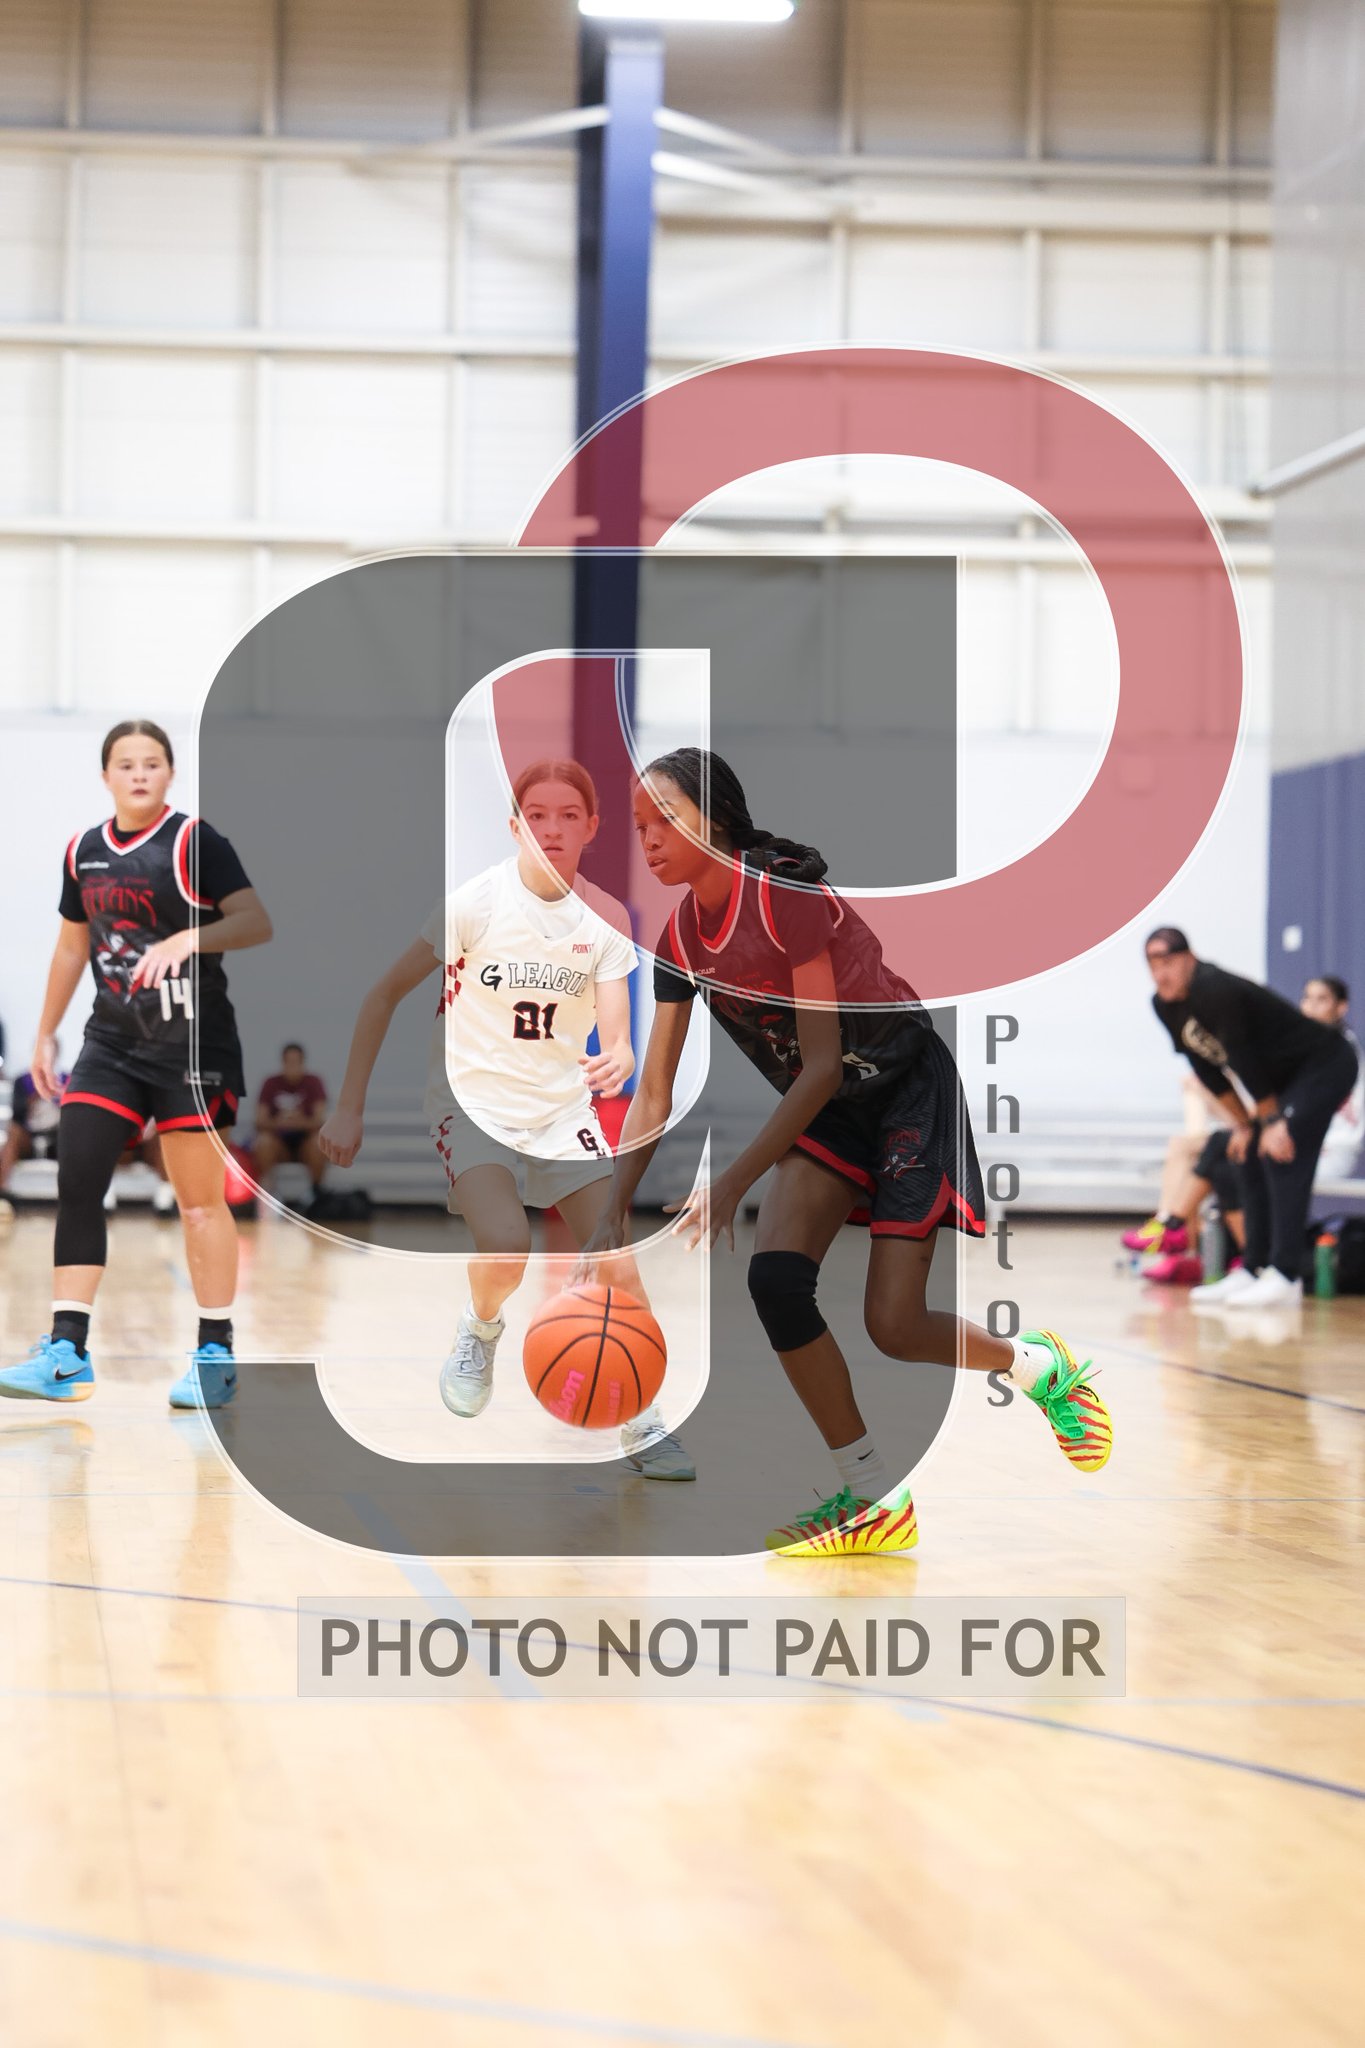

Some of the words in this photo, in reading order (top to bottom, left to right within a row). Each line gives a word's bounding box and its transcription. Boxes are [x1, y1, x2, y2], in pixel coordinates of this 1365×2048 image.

[480, 964, 503, 992] G
[160, 977, 194, 1022] 14
[513, 1000, 558, 1040] 21
